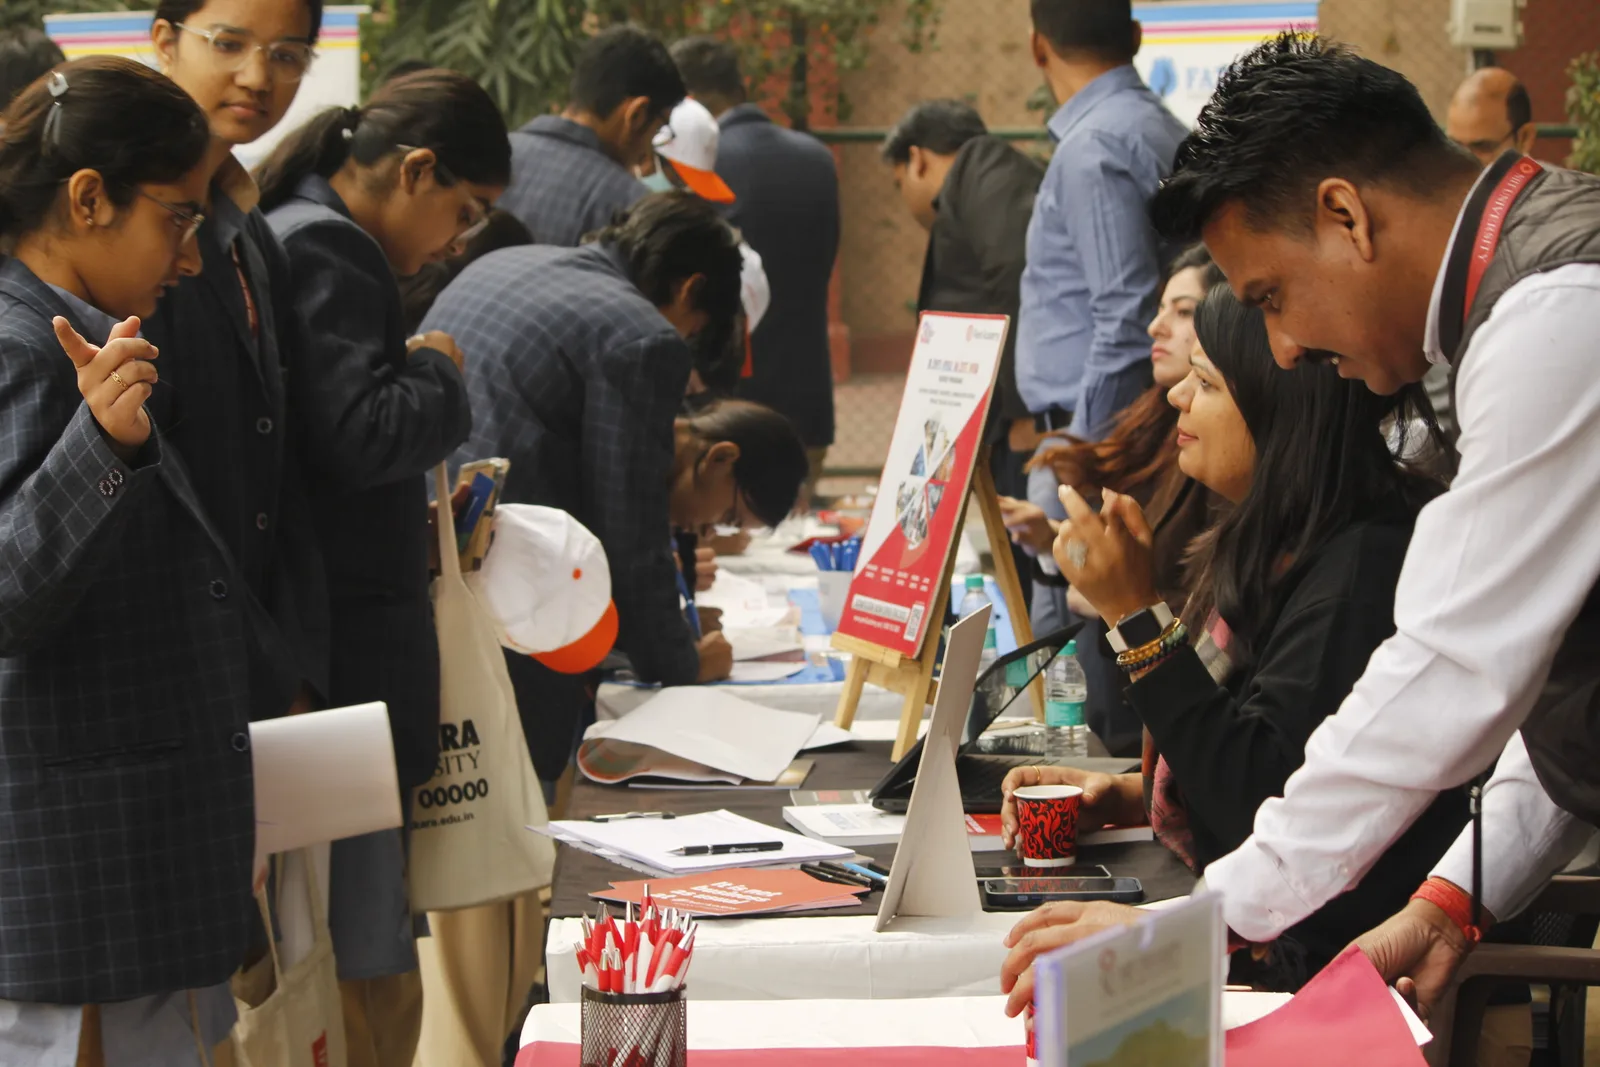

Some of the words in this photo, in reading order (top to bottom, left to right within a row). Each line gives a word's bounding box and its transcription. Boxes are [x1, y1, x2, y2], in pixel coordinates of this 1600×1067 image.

[1478, 188, 1514, 264] UNIVERSITY
[690, 885, 771, 902] business
[726, 884, 749, 892] is
[744, 889, 783, 897] not
[693, 893, 751, 904] usual
